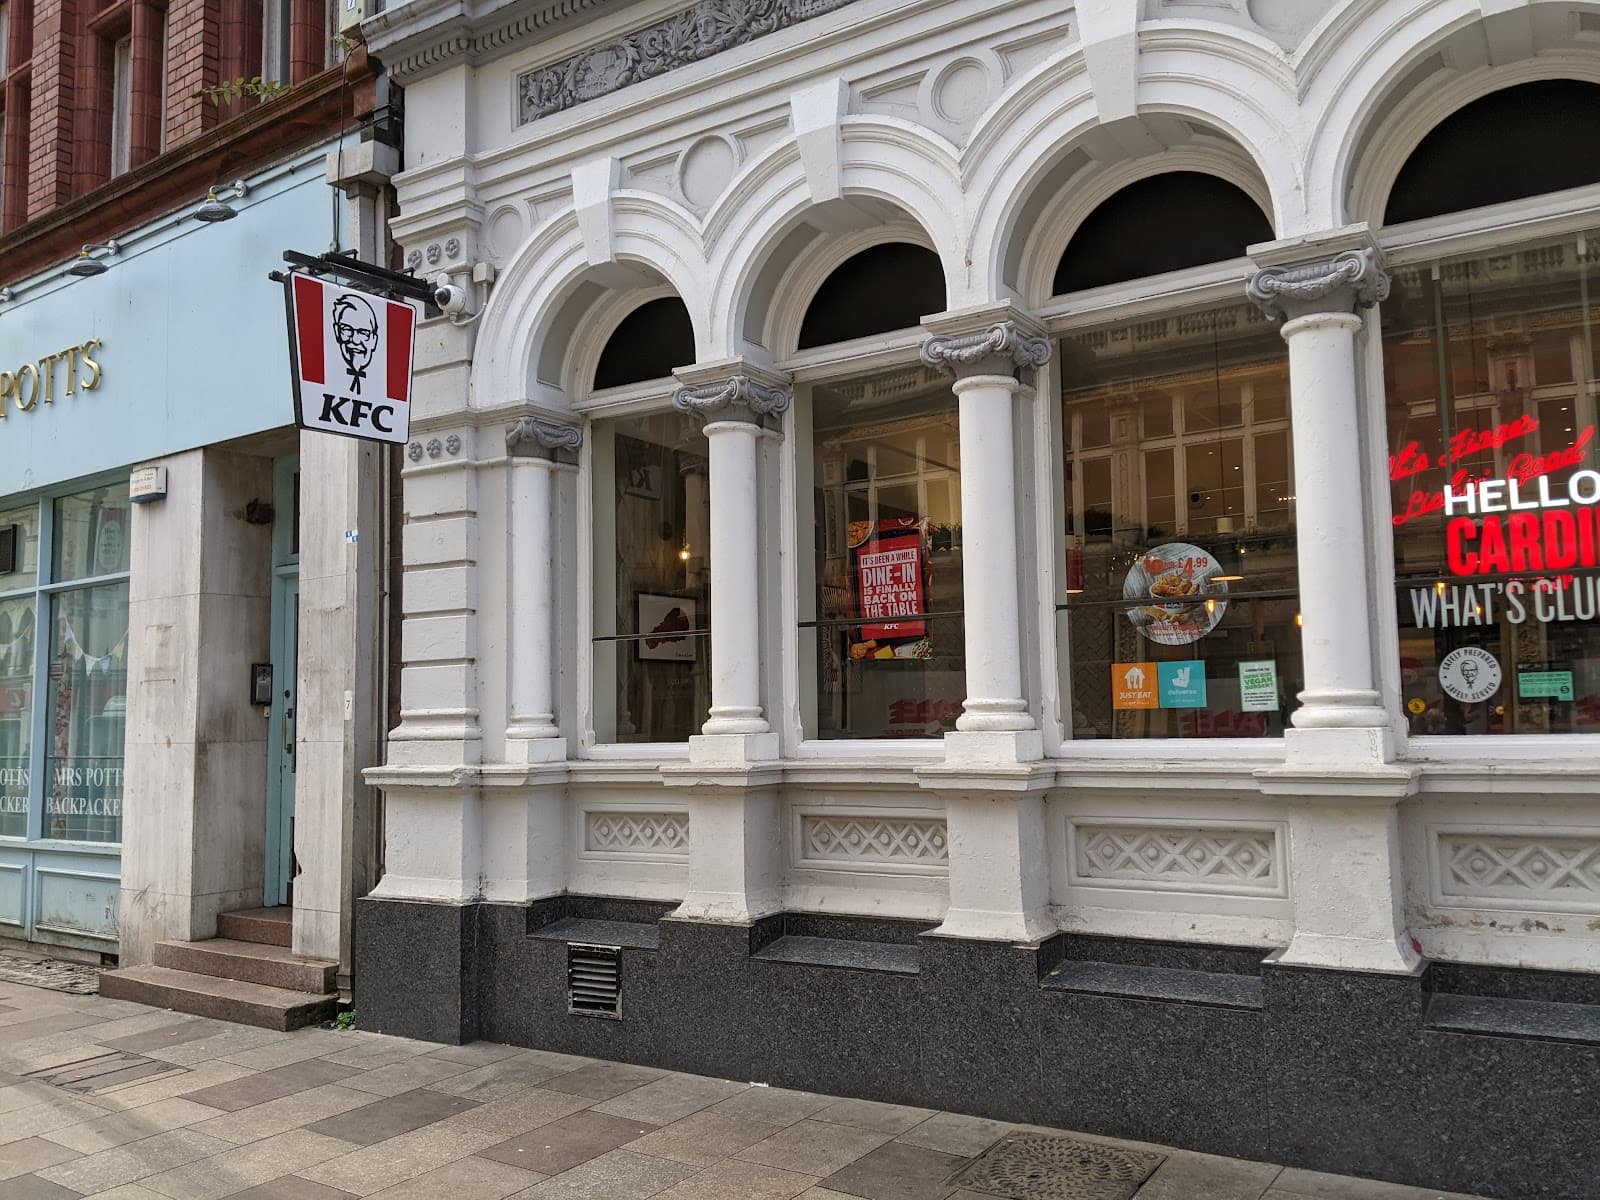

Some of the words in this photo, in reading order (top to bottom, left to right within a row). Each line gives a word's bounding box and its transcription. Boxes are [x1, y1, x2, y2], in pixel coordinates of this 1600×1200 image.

[0, 337, 102, 418] POTTS
[318, 393, 394, 433] KFC
[1438, 413, 1540, 467] Finger
[1508, 424, 1595, 487] Good
[1443, 469, 1600, 516] HELLO
[1446, 506, 1600, 577] CARDI
[875, 554, 890, 565] BEEN
[896, 550, 915, 561] WHILE
[862, 562, 917, 587] DINE-IN
[864, 587, 873, 596] IS
[876, 582, 917, 594] FINALLY
[864, 593, 896, 605] BACK
[900, 591, 917, 602] ON
[864, 604, 884, 618] THE
[886, 600, 918, 617] TABLE
[1410, 580, 1527, 629] WHAT'S
[1534, 575, 1600, 624] CLU
[1243, 676, 1273, 686] VEGAN
[346, 700, 351, 710] 7
[1119, 691, 1136, 700] JUST
[1137, 691, 1153, 699] EAT
[54, 767, 82, 786] MRS
